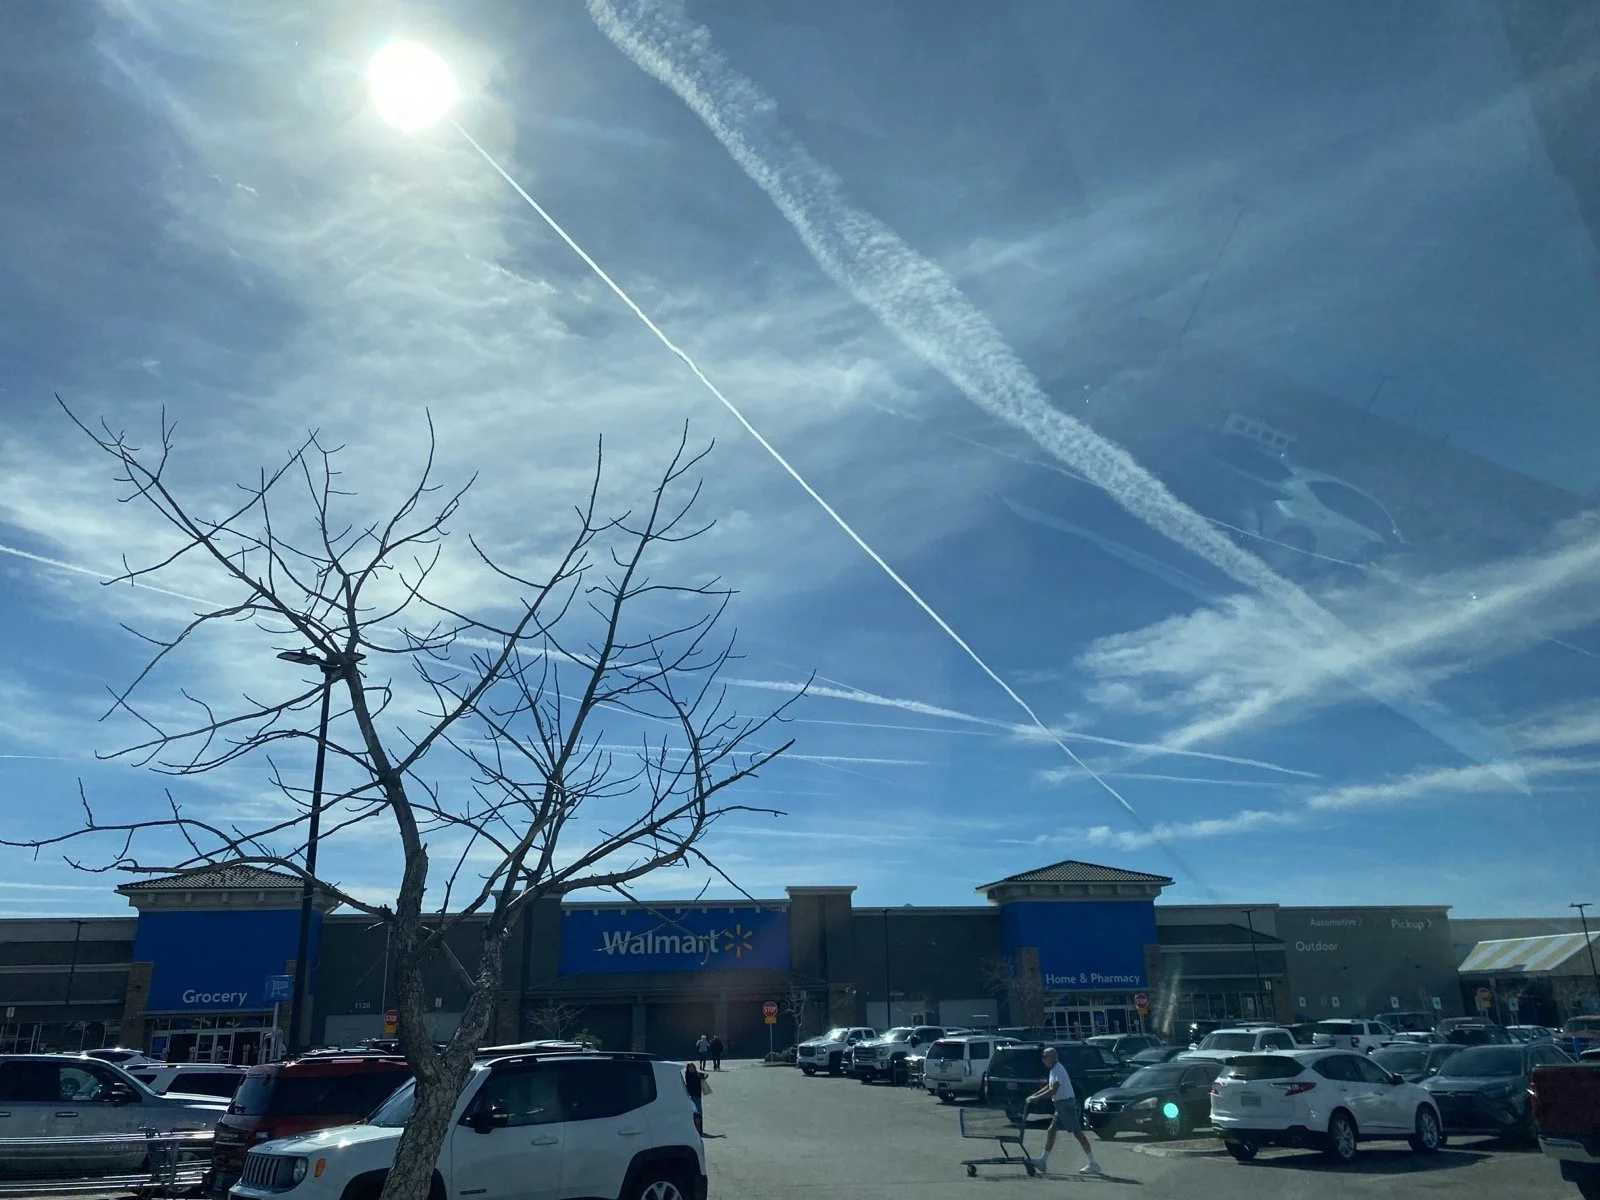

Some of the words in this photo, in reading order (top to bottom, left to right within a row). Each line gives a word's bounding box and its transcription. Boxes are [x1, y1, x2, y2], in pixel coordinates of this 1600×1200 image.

[1310, 918, 1357, 926] Automotive
[1391, 918, 1424, 931] Pickup
[602, 929, 719, 955] Walmart
[1295, 940, 1339, 951] Outdoor
[1045, 974, 1077, 984] Home
[1079, 973, 1088, 984] &
[1090, 973, 1140, 985] Pharmacy
[182, 989, 248, 1006] Grocery
